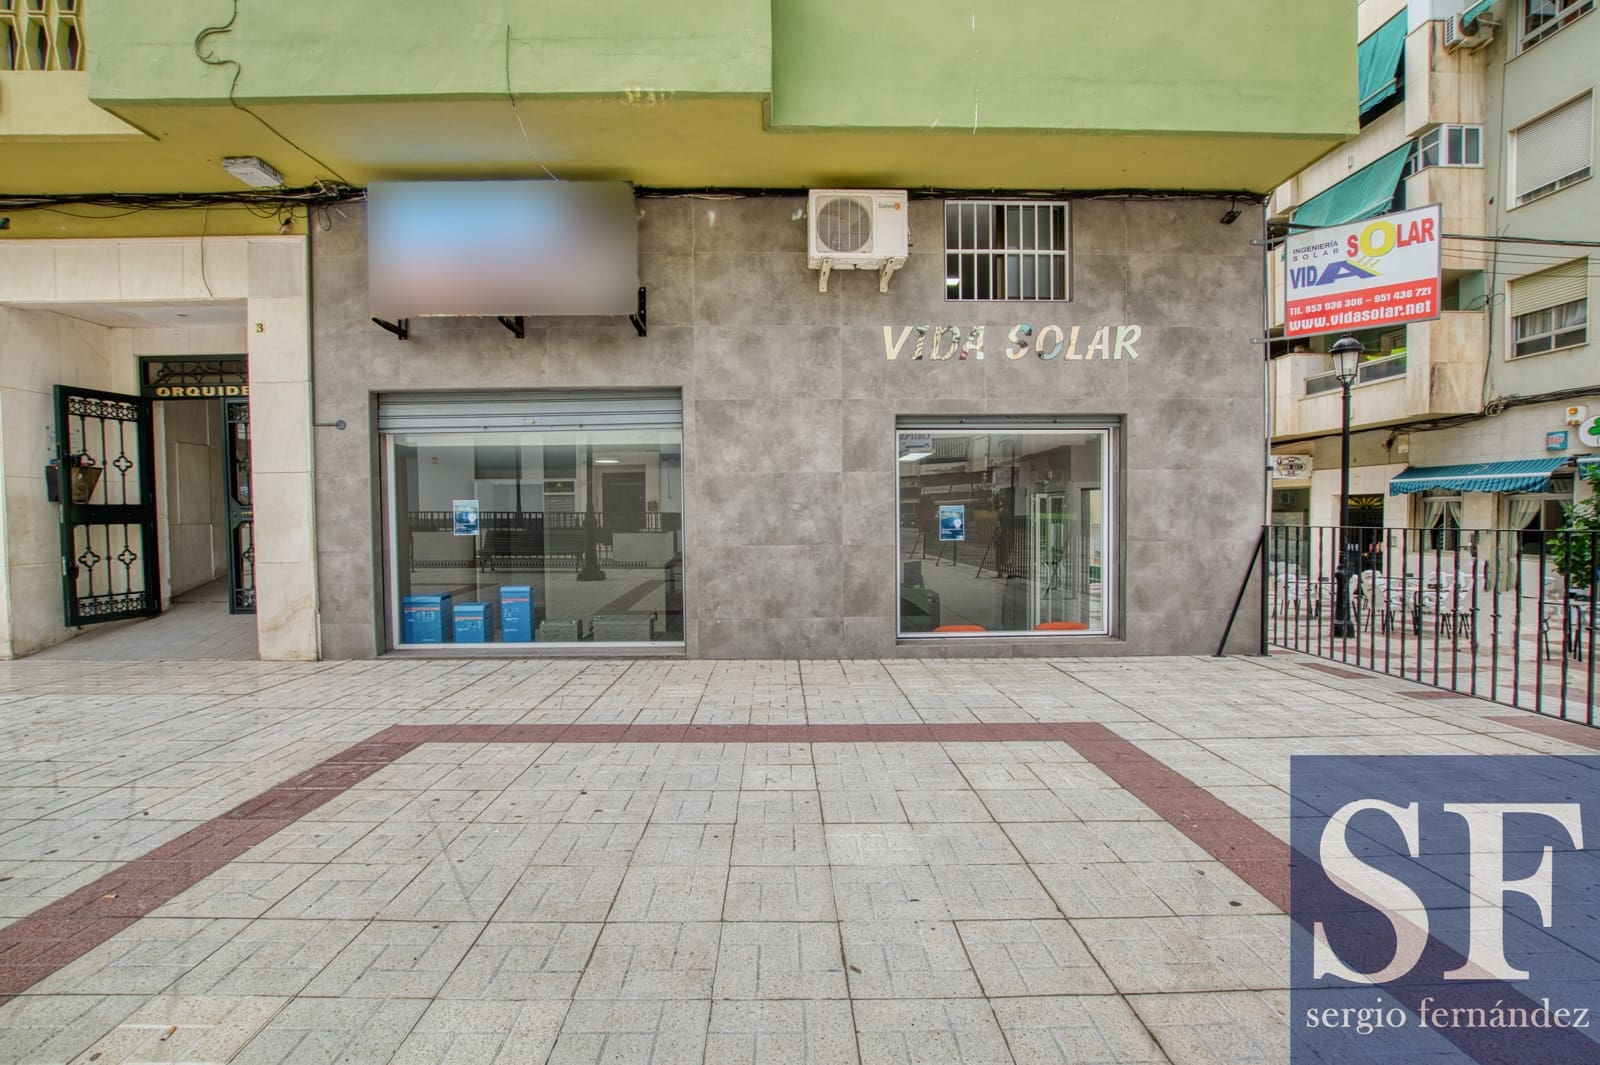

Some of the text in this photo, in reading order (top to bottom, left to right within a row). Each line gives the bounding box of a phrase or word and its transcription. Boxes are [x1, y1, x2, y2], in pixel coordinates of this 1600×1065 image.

[1293, 241, 1339, 254] INGENIERÍA
[1347, 217, 1434, 257] SOLAR
[1292, 247, 1340, 262] SOLAR
[1289, 260, 1377, 289] VIDA
[1415, 286, 1432, 297] 721
[1289, 300, 1432, 331] www.vidasolar.net
[256, 322, 264, 333] 3
[882, 323, 1142, 361] VIDA SOLAR
